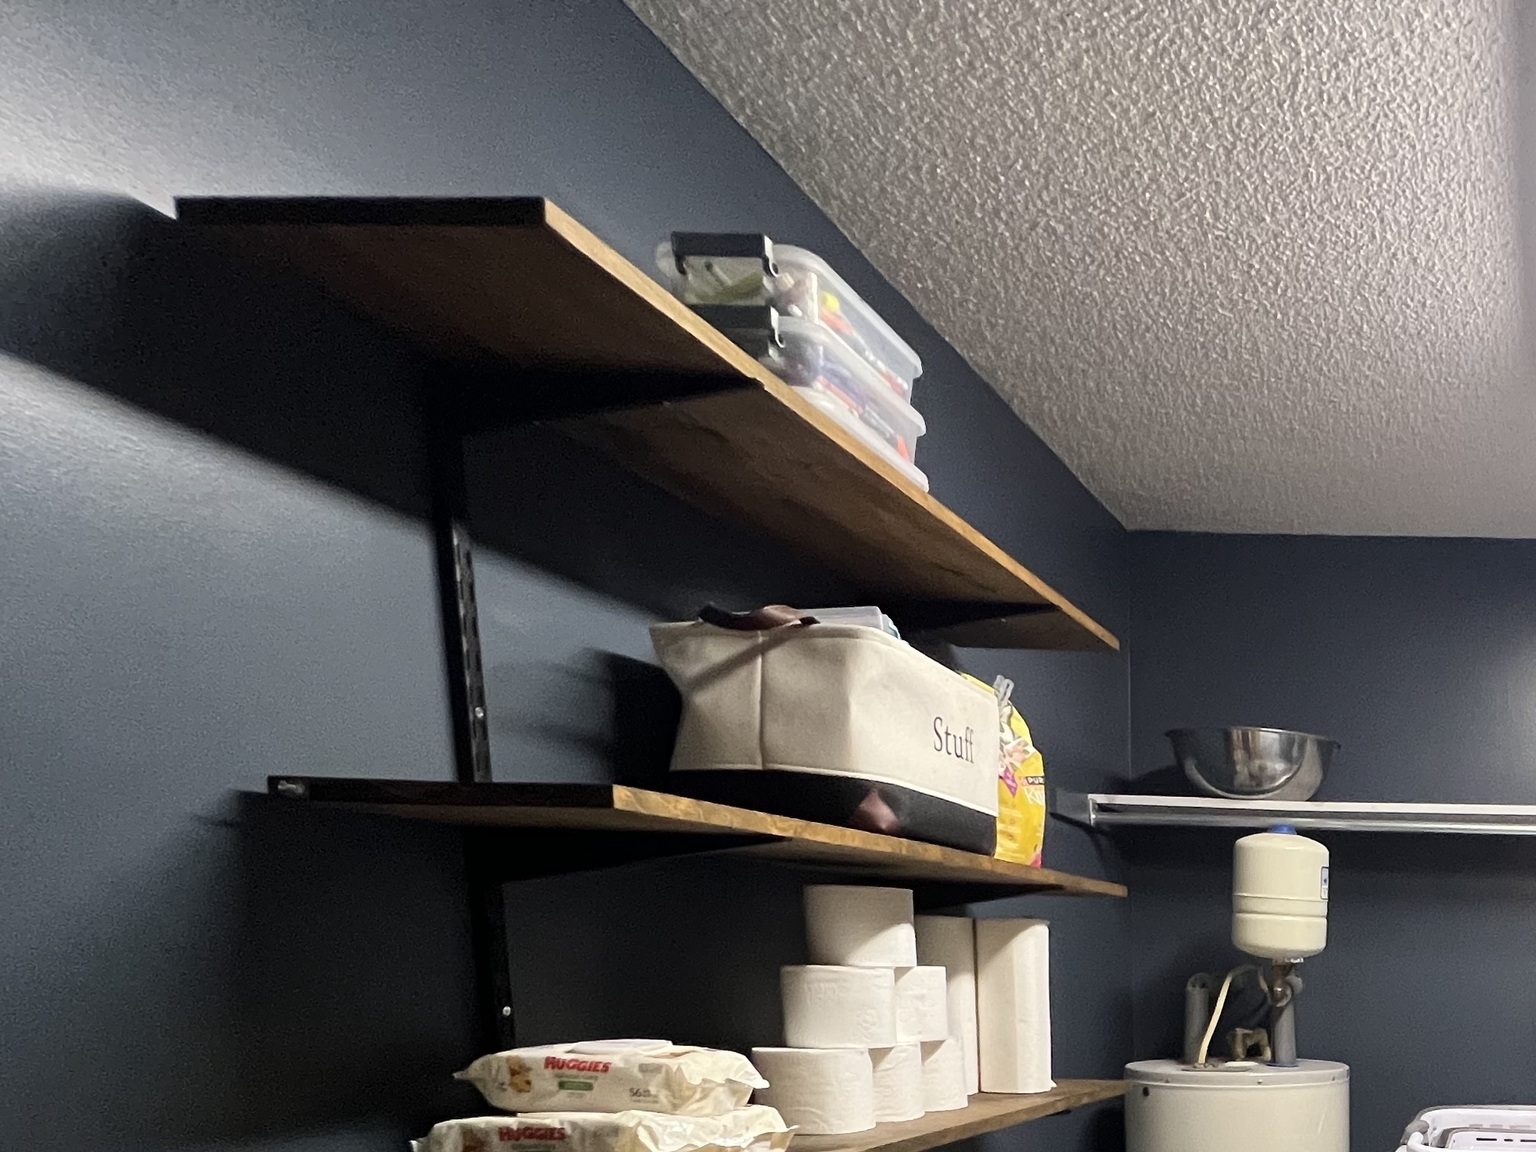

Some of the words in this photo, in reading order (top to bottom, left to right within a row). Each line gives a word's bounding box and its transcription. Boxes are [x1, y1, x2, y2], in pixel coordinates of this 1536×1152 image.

[933, 716, 975, 764] Stuff
[544, 1056, 612, 1073] HUGGIES
[500, 1126, 566, 1142] HUGGIES
